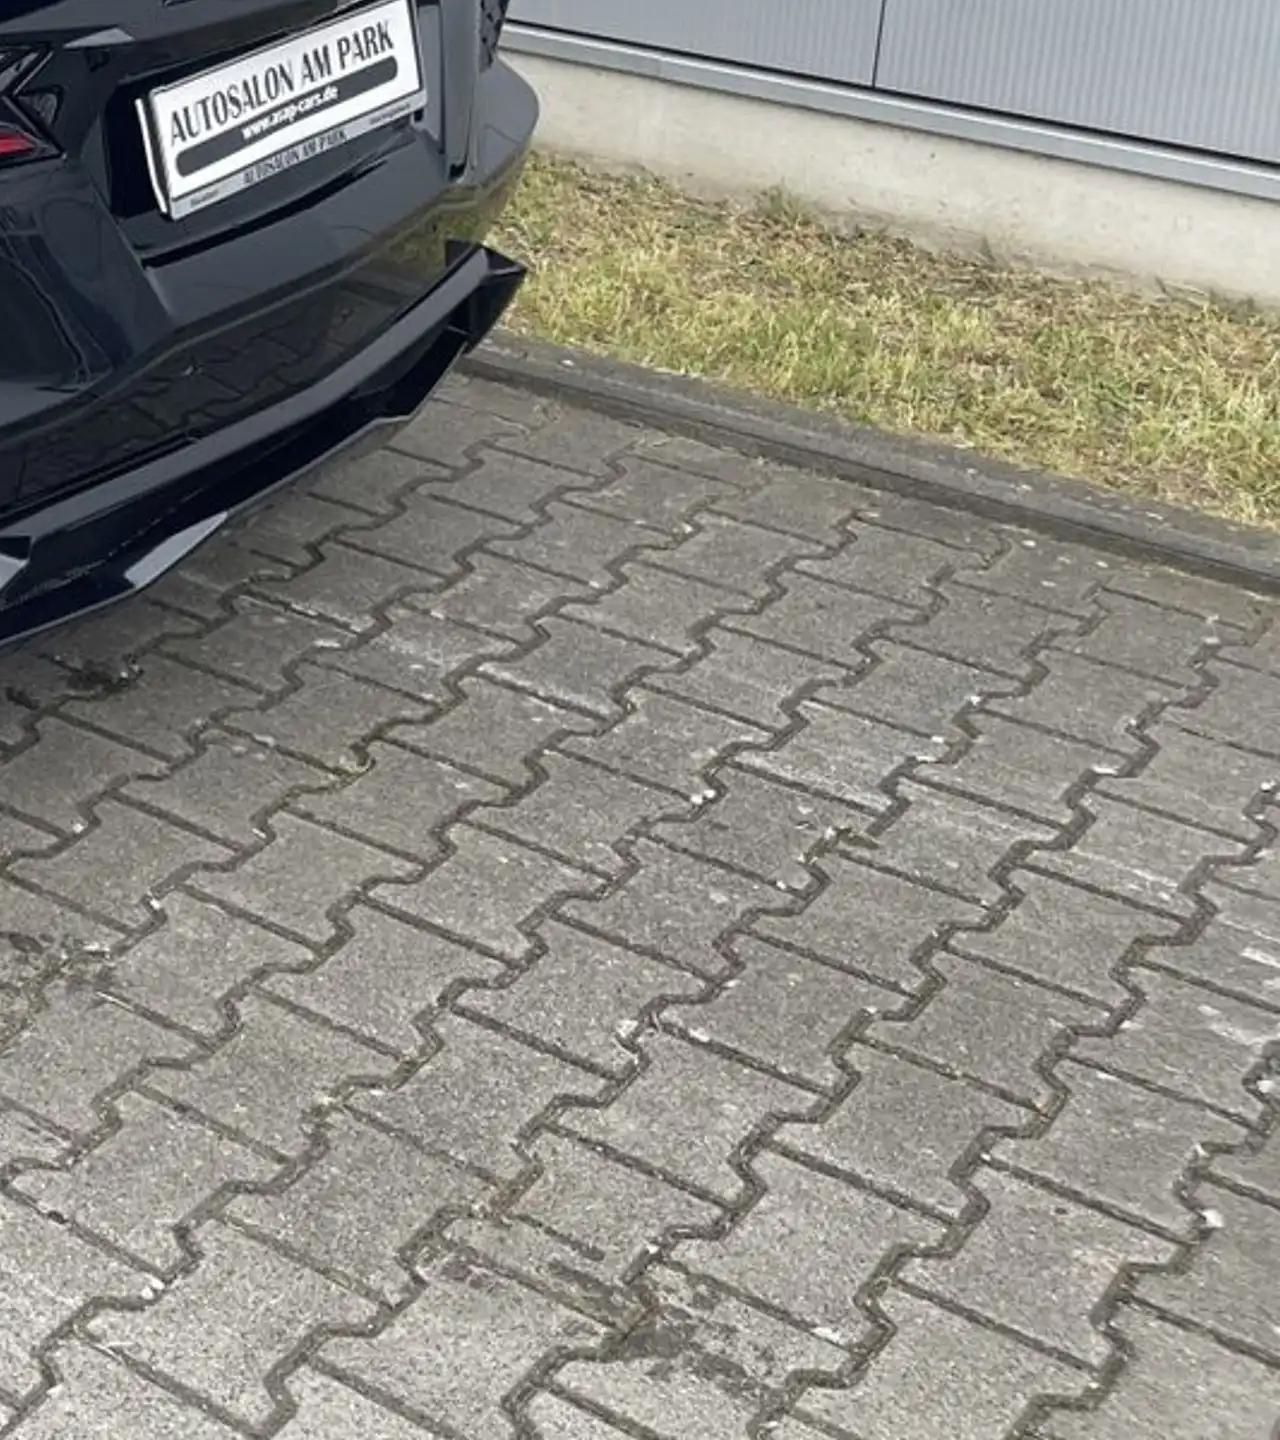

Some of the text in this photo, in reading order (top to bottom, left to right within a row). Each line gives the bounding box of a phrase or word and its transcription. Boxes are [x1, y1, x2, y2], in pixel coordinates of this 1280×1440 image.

[171, 19, 395, 148] AUTOSALON AM PARK
